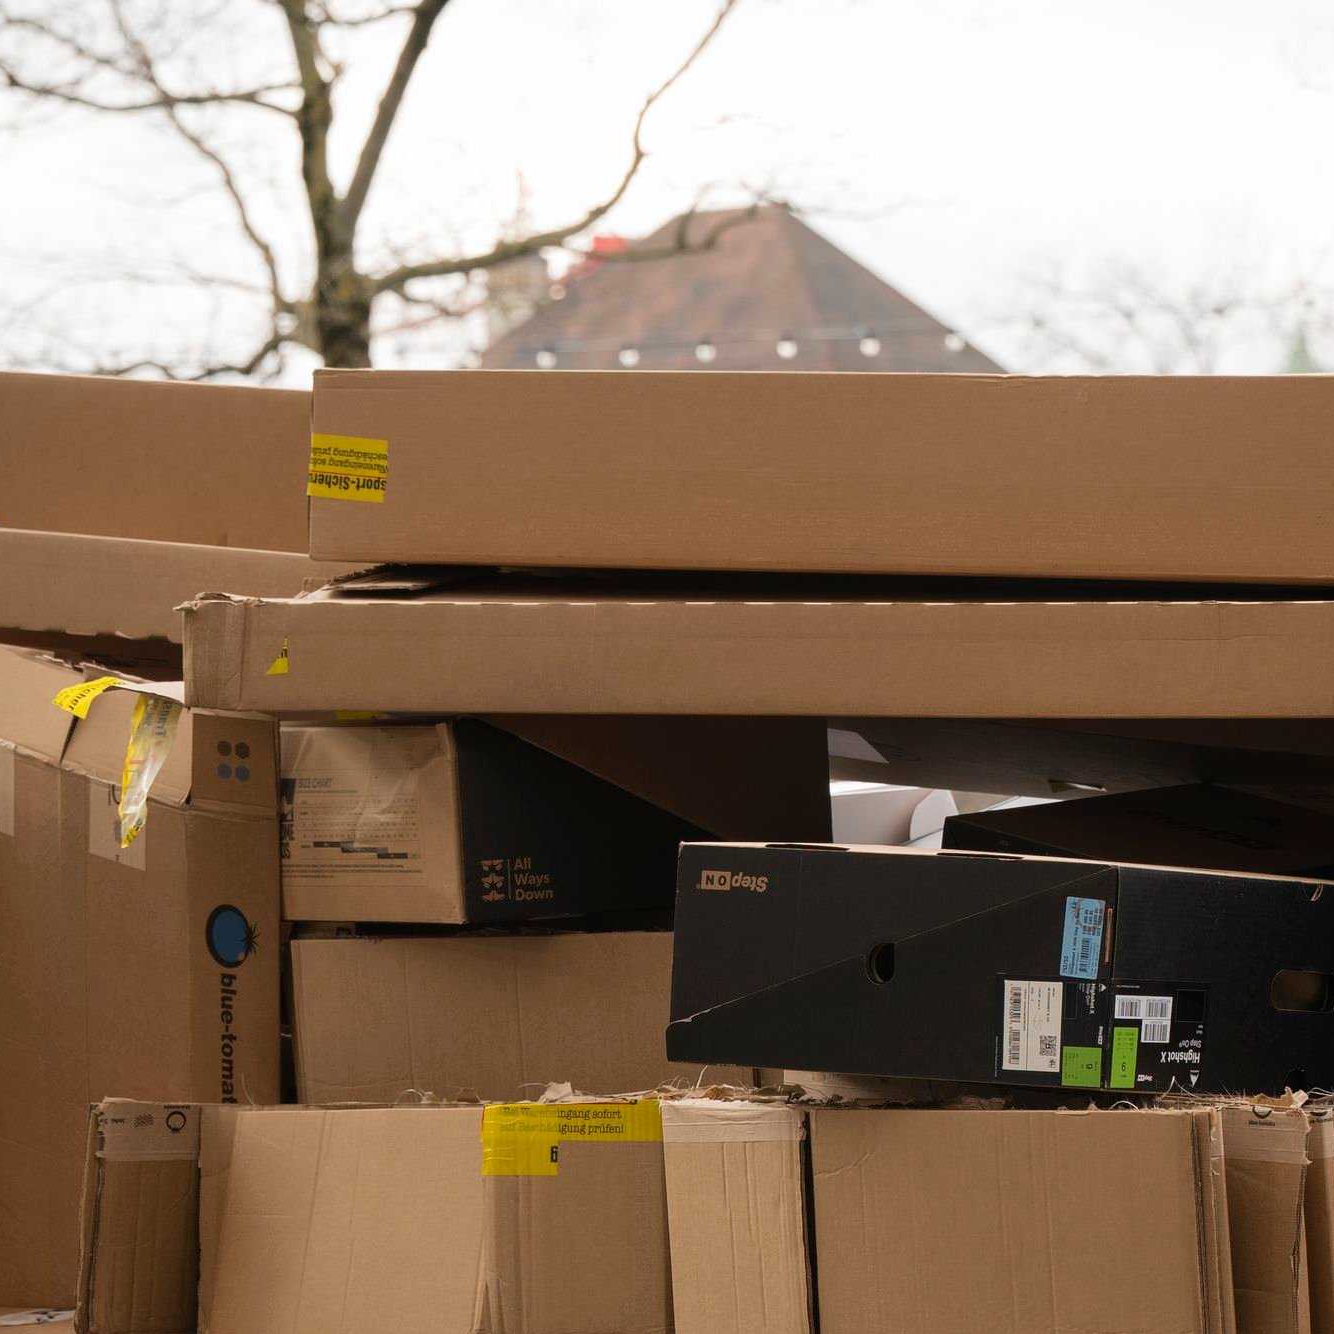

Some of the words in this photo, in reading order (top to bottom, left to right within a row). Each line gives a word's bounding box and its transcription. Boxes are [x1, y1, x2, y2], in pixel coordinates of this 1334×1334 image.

[514, 857, 532, 870] All
[514, 872, 551, 887] Ways
[515, 887, 554, 901] Down
[1189, 1039, 1202, 1048] Step
[1160, 1051, 1167, 1063] X
[1168, 1049, 1201, 1064] Highshot
[592, 1108, 622, 1119] sofort
